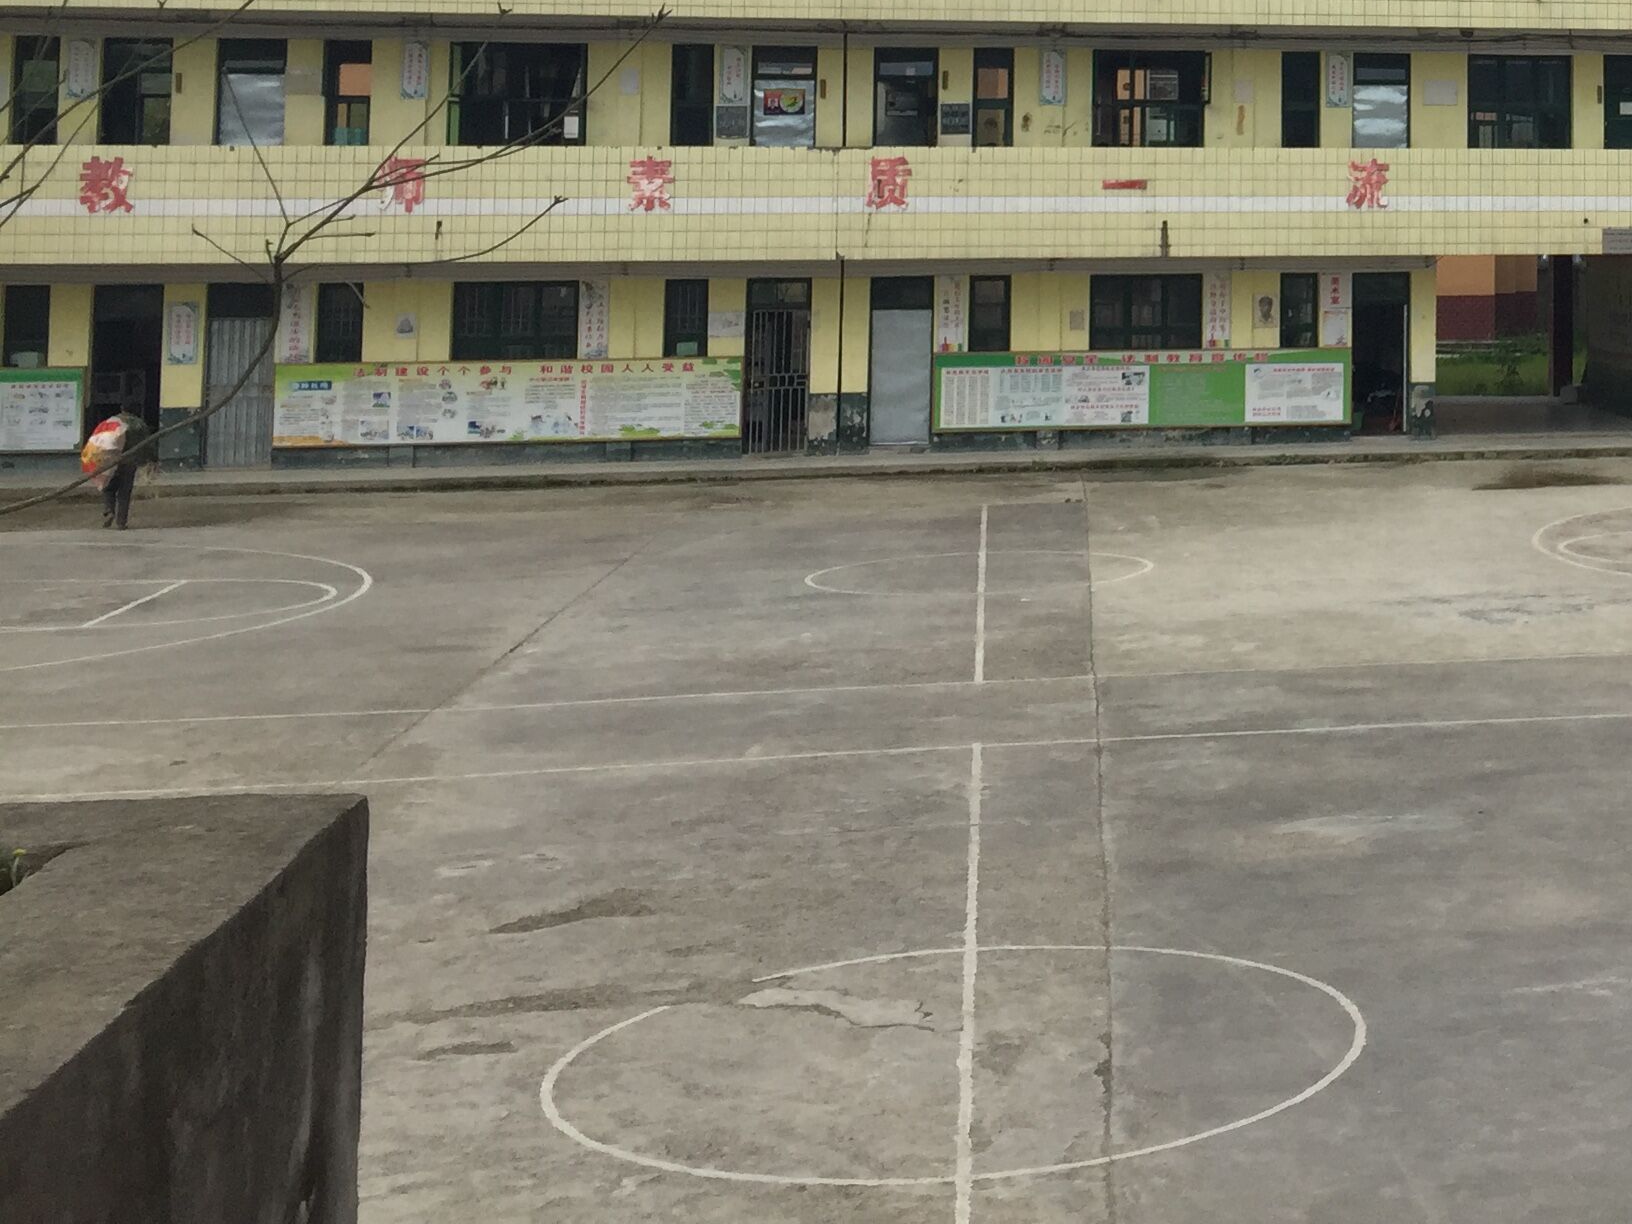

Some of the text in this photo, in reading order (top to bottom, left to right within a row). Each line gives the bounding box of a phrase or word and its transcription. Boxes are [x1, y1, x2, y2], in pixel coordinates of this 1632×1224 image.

[79, 156, 1389, 214] 教师素质一流
[540, 362, 695, 374] 和谐校园人人受益
